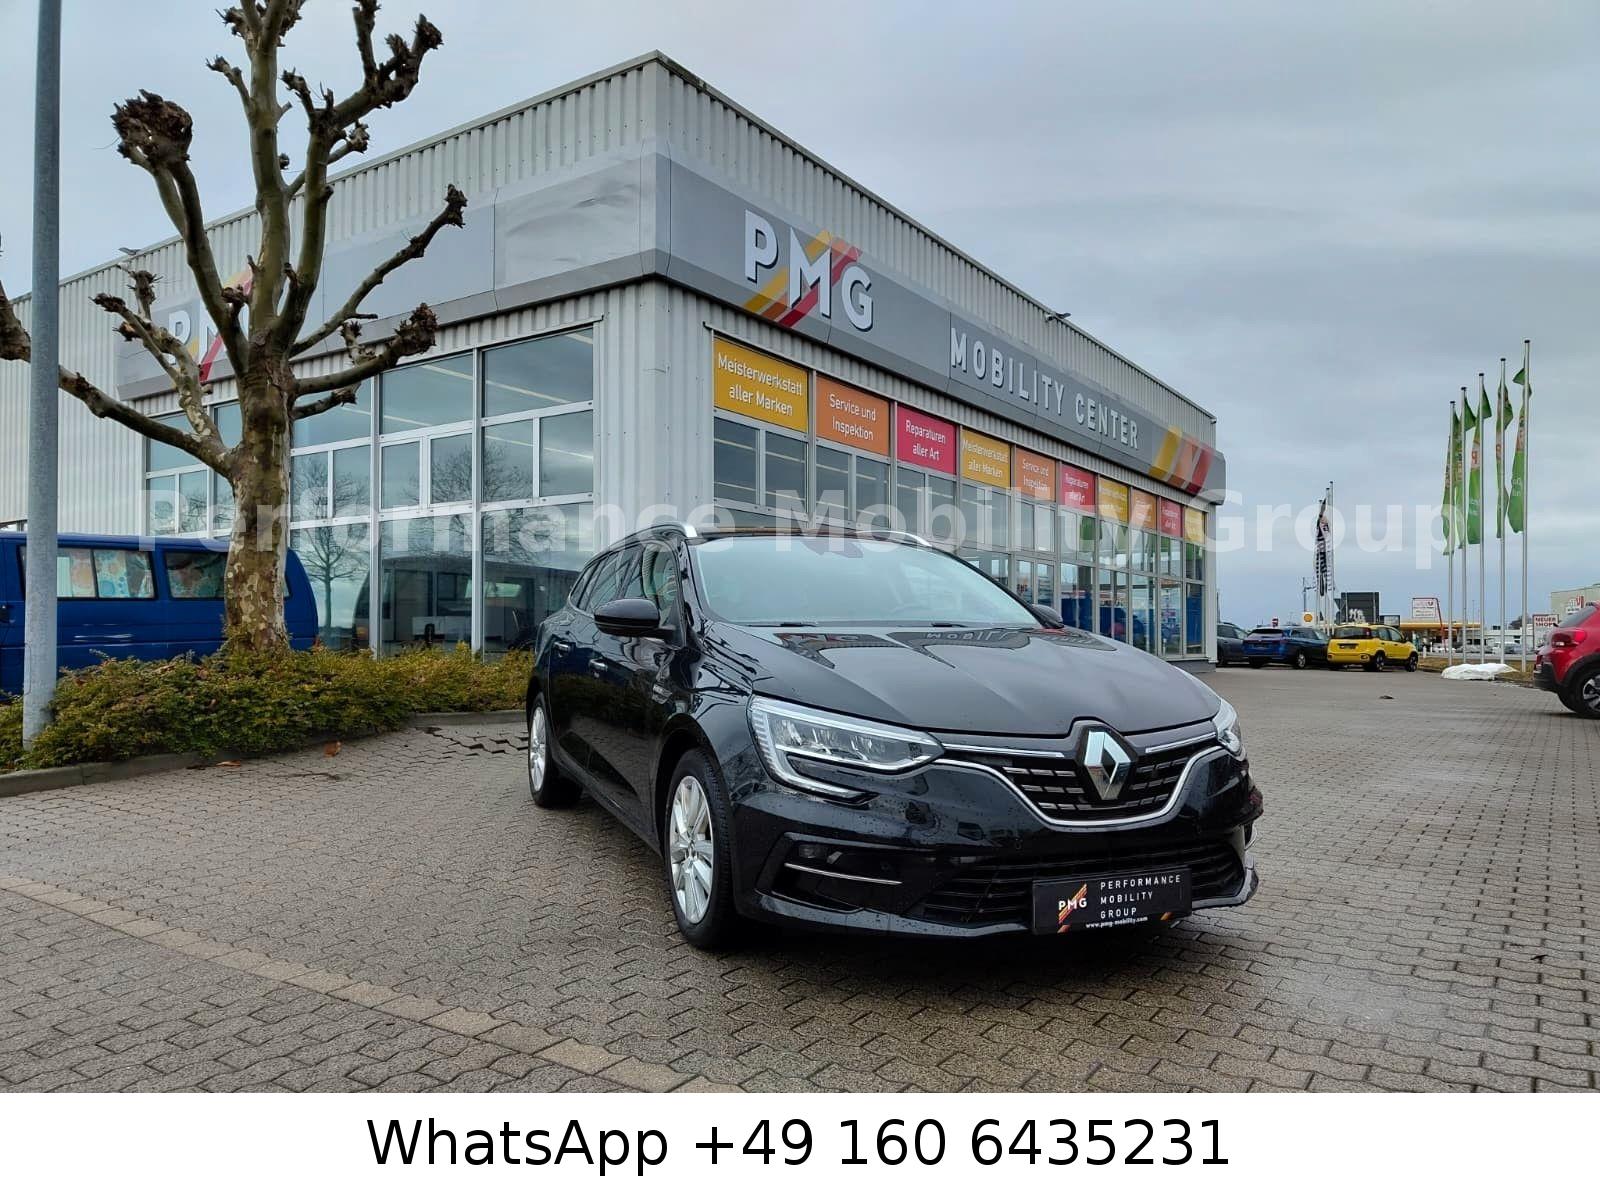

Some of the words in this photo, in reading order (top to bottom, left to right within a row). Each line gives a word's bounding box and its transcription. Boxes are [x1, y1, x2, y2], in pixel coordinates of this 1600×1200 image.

[745, 209, 874, 332] PMG
[718, 353, 803, 396] Meisterwerkstatt
[728, 384, 753, 404] aller
[756, 391, 793, 417] Marken
[951, 327, 1065, 416] MOBILITY
[1075, 392, 1138, 449] CENTER
[829, 393, 860, 417] Service
[861, 407, 876, 422] und
[832, 416, 874, 440] Inspektion
[905, 419, 946, 445] Reparaturen
[912, 443, 929, 457] aller
[929, 447, 940, 461] Art
[1101, 875, 1181, 890] PERFORMANCE
[1058, 897, 1088, 911] PMG
[1100, 891, 1153, 905] MOBILITY
[1101, 907, 1137, 919] GROUP
